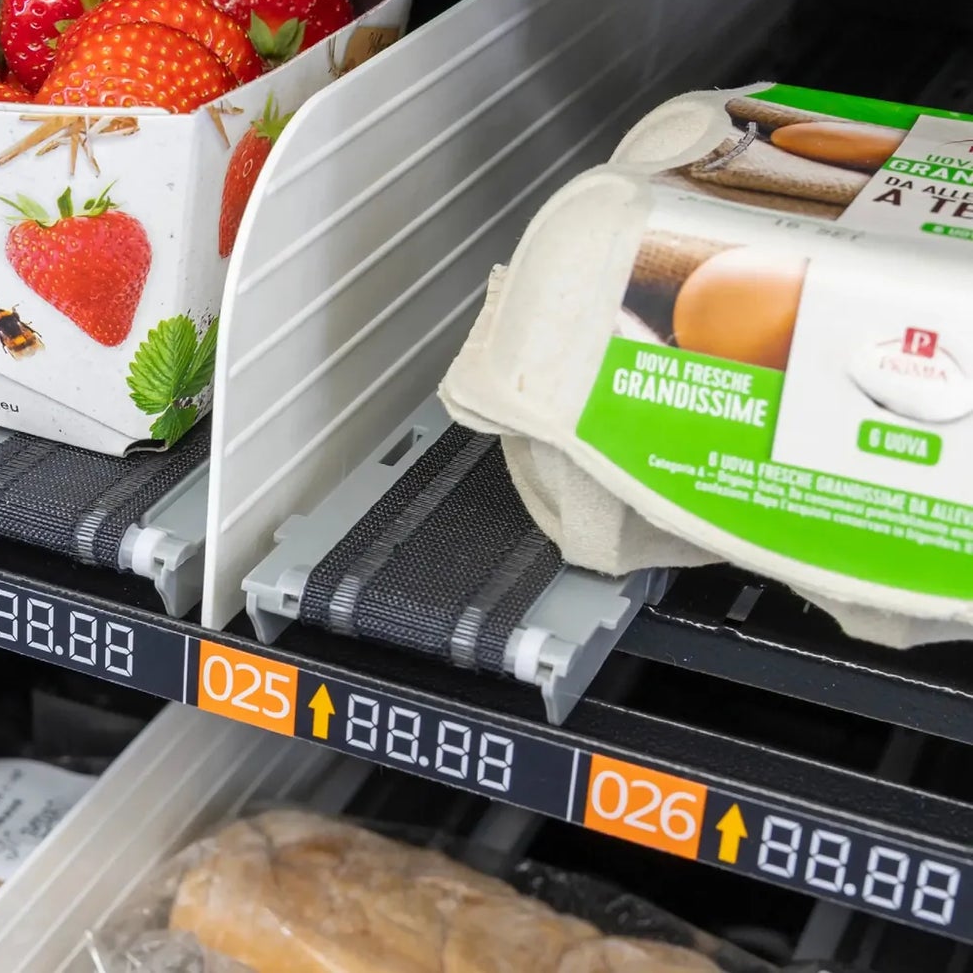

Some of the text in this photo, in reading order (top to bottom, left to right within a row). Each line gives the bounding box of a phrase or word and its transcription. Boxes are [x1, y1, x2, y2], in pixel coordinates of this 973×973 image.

[873, 188, 902, 206] A
[884, 176, 914, 190] DA
[635, 350, 754, 395] UOVA FRESCHE
[612, 367, 770, 428] GRANDISSIME
[884, 431, 928, 459] UOVA
[202, 654, 515, 793] 025 88.88
[591, 768, 961, 927] 026 88.88
